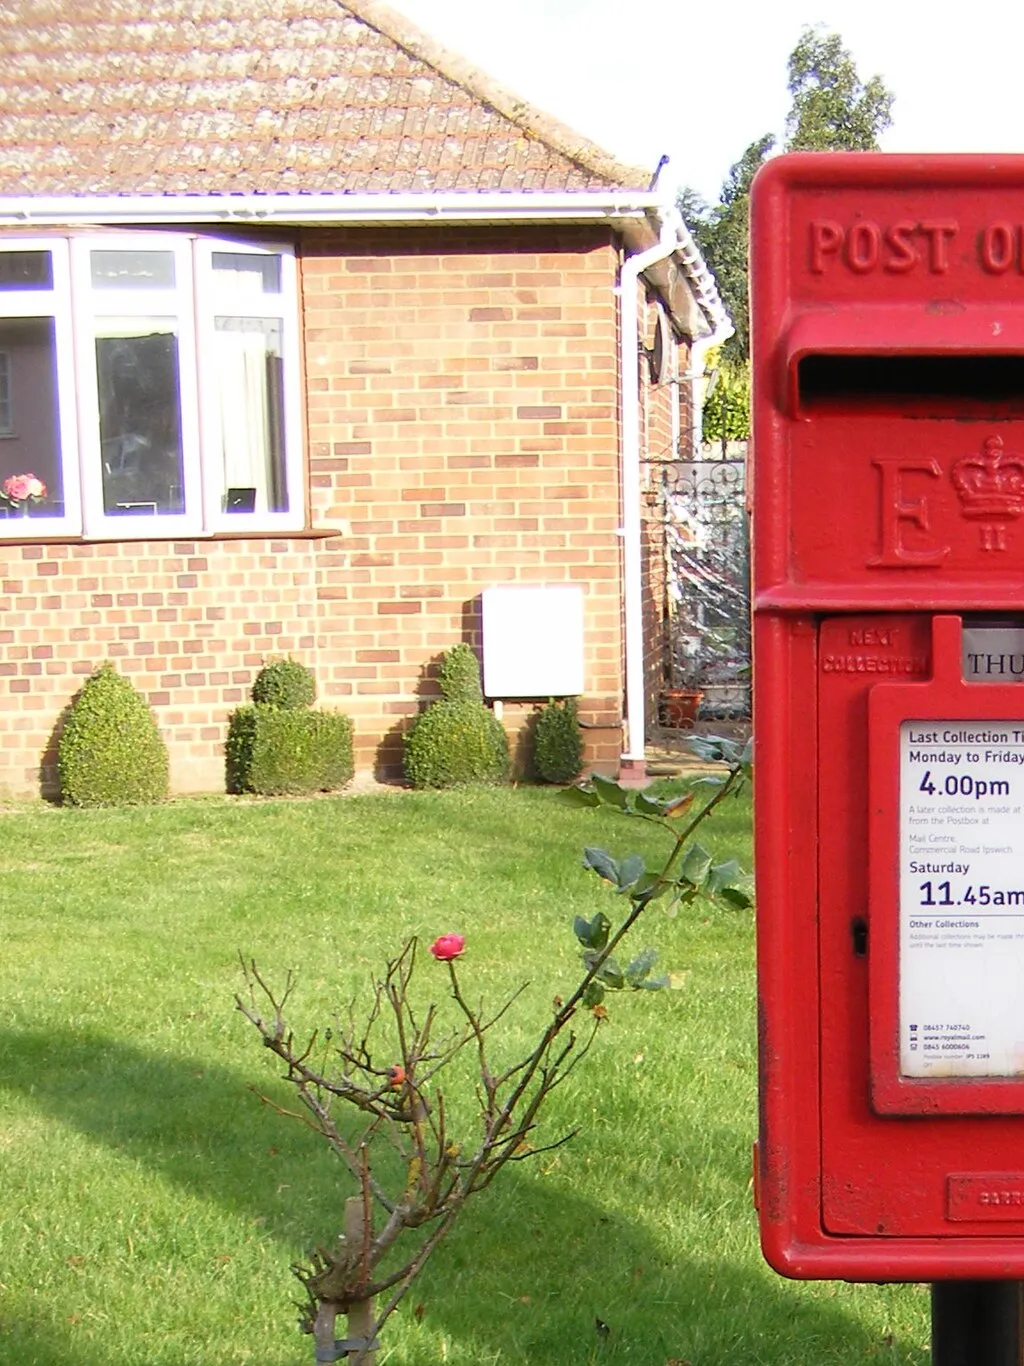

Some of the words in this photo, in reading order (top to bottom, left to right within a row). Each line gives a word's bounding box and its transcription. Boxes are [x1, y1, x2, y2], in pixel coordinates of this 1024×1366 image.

[809, 220, 959, 274] POST
[865, 456, 951, 570] E
[849, 628, 899, 646] NEXT
[822, 655, 929, 673] COLLECTION
[909, 731, 938, 743] Last
[943, 731, 1008, 743] Collection
[909, 751, 961, 765] Monday
[966, 752, 980, 763] to
[919, 770, 1010, 800] 4.00pm
[909, 805, 915, 813] A
[917, 805, 935, 813] later
[938, 805, 976, 813] collection
[988, 805, 1010, 813] made
[908, 816, 928, 824] from
[947, 816, 978, 824] Postbox
[909, 834, 926, 842] Mail
[928, 833, 955, 842] Centre
[909, 845, 956, 854] Commercial
[960, 845, 980, 853] Road
[982, 845, 1013, 855] Ipswich
[909, 861, 970, 875] Saturday
[909, 920, 932, 928] Other
[935, 920, 979, 928] Collections
